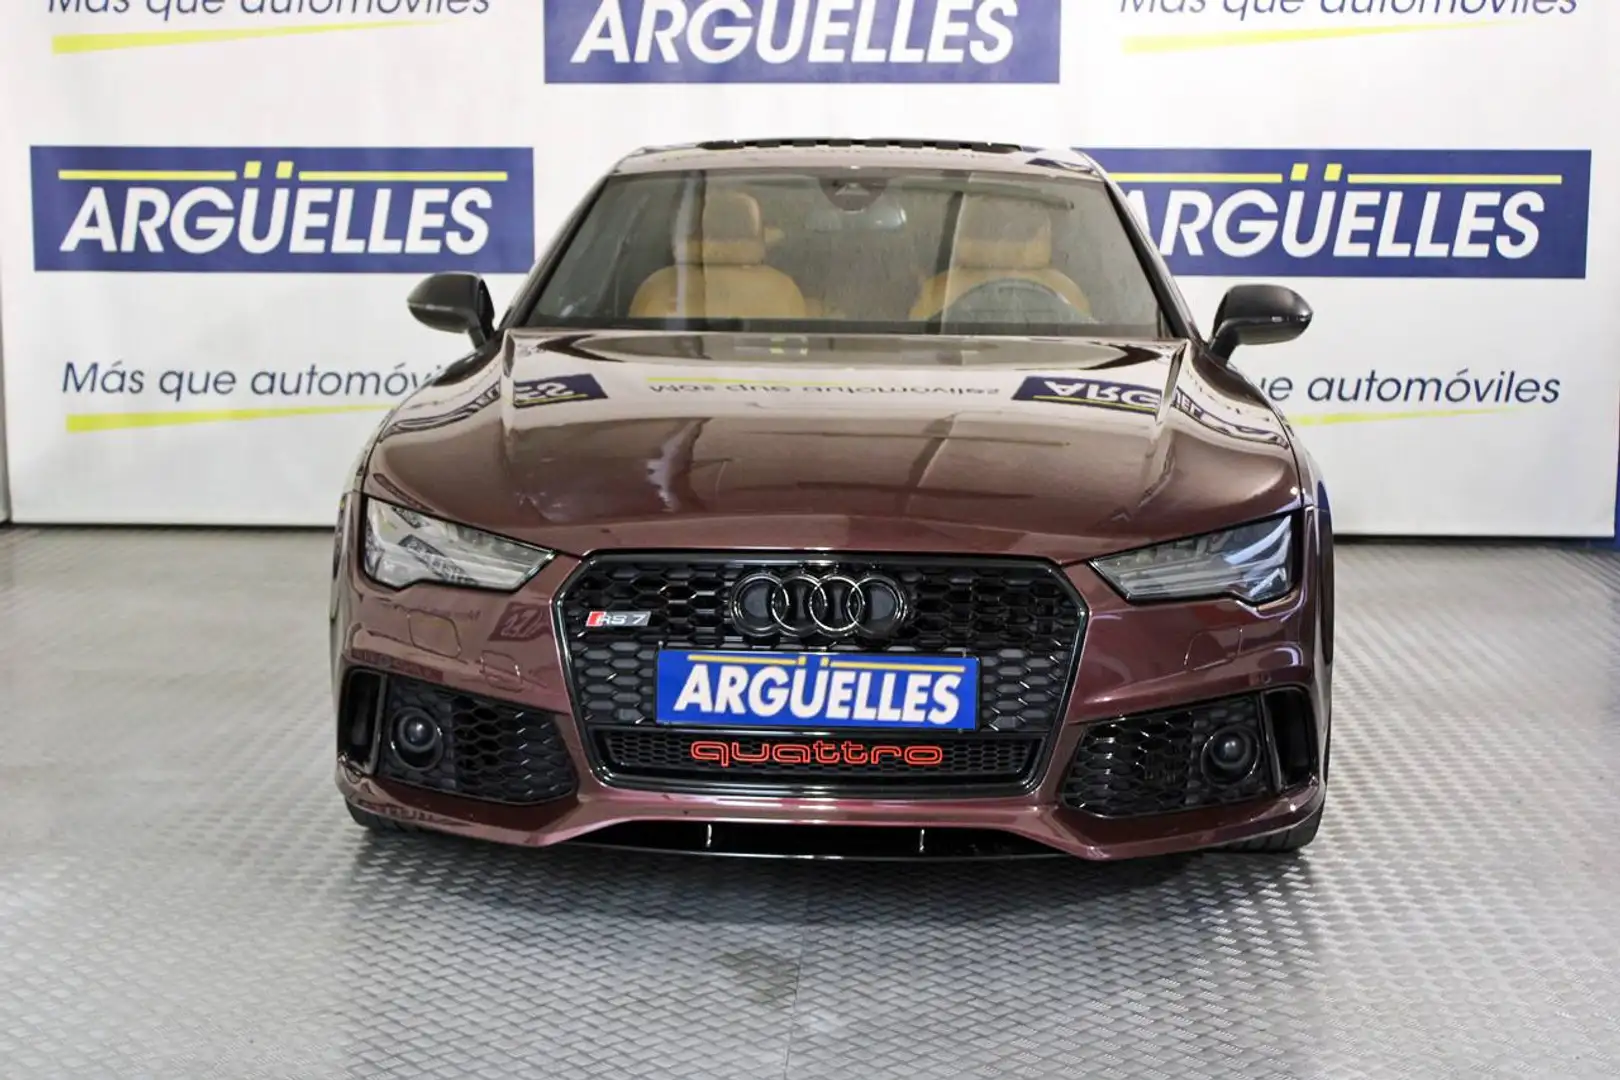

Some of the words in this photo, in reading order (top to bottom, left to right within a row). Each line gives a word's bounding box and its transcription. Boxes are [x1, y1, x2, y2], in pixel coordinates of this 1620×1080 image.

[60, 161, 492, 255] ARGÜELLES
[62, 360, 145, 394] Más
[158, 371, 237, 402] que
[251, 363, 441, 396] automóv
[1307, 368, 1561, 403] automóviles
[673, 657, 965, 725] ARGÜELLES
[690, 740, 943, 767] quattro
